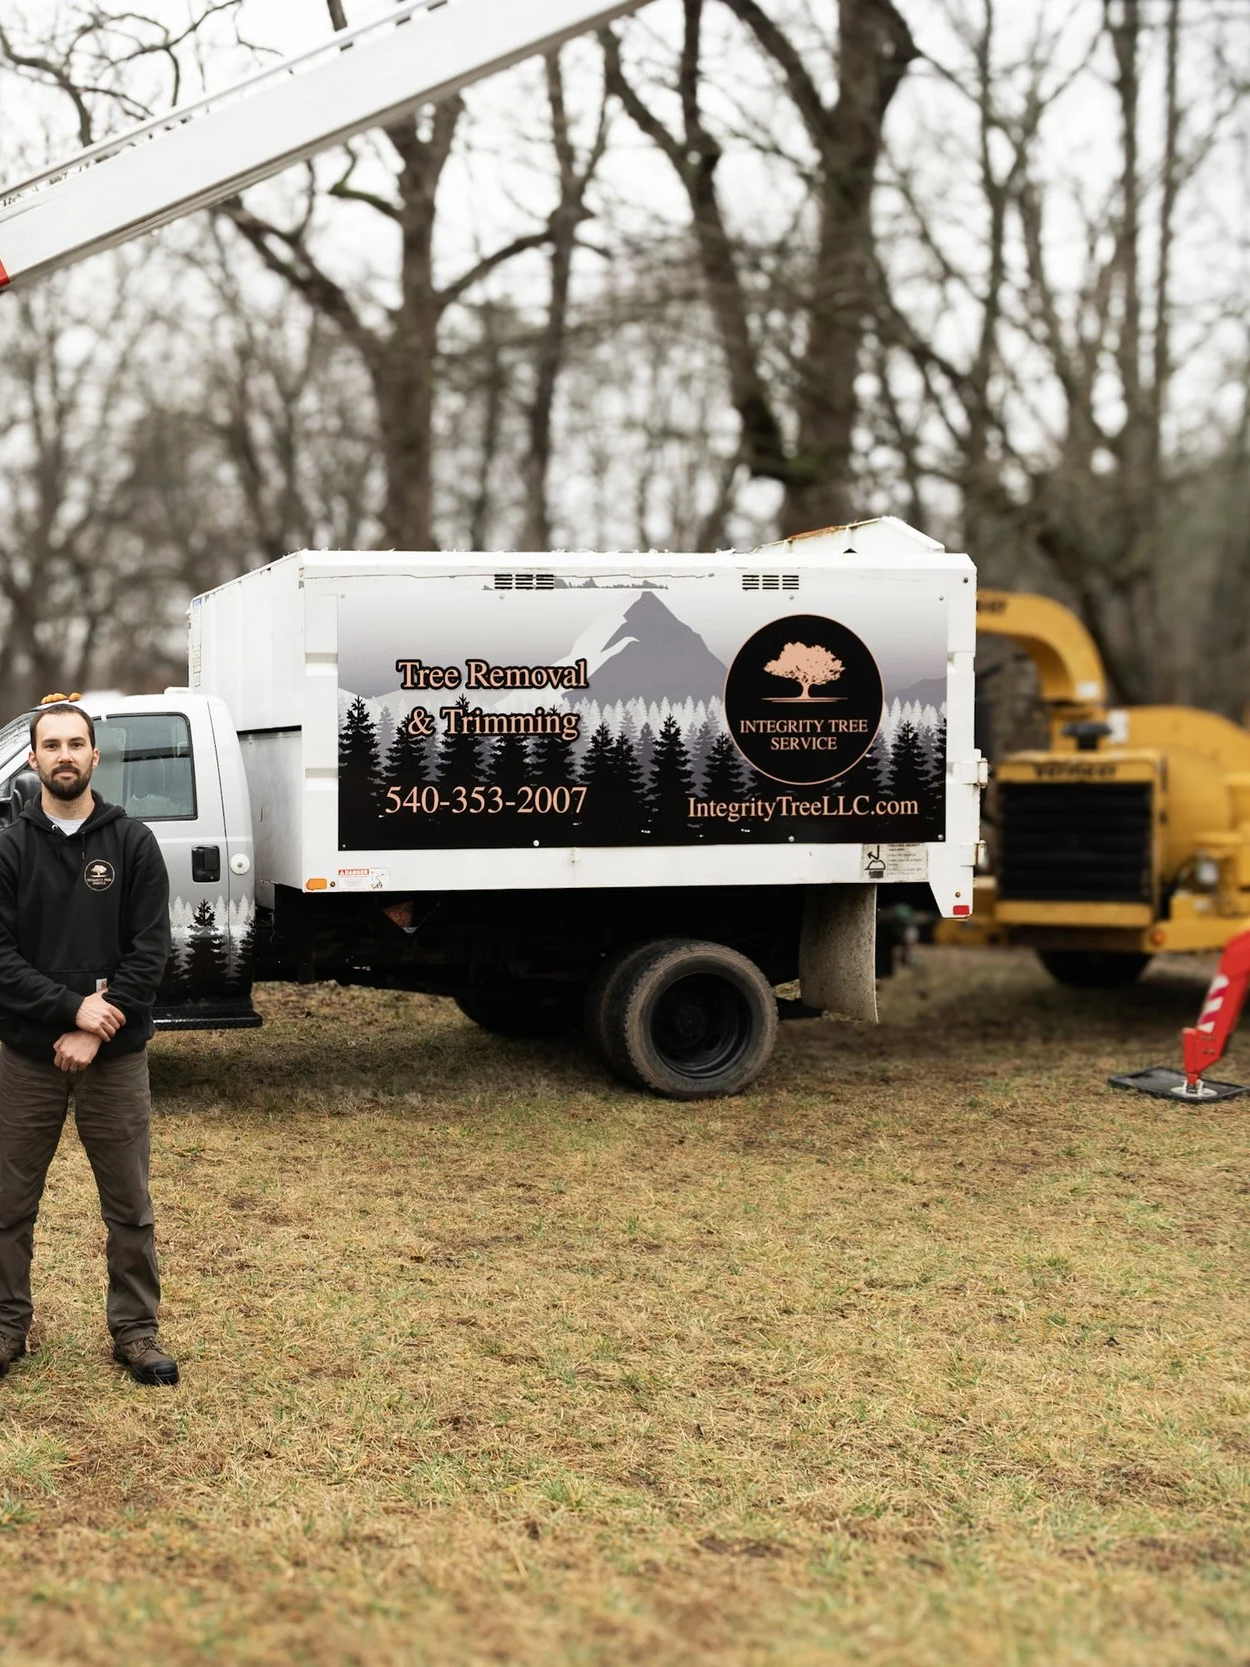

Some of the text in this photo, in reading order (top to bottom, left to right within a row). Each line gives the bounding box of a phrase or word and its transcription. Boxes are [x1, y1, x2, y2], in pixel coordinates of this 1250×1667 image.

[397, 659, 588, 688] Tree Removal
[408, 707, 579, 741] & Trimming
[740, 719, 868, 733] INTEGRITY TREE
[770, 737, 837, 750] SERVICE
[385, 786, 588, 814] 540-353-2007
[687, 795, 919, 822] IntegrityTreeLLC.com
